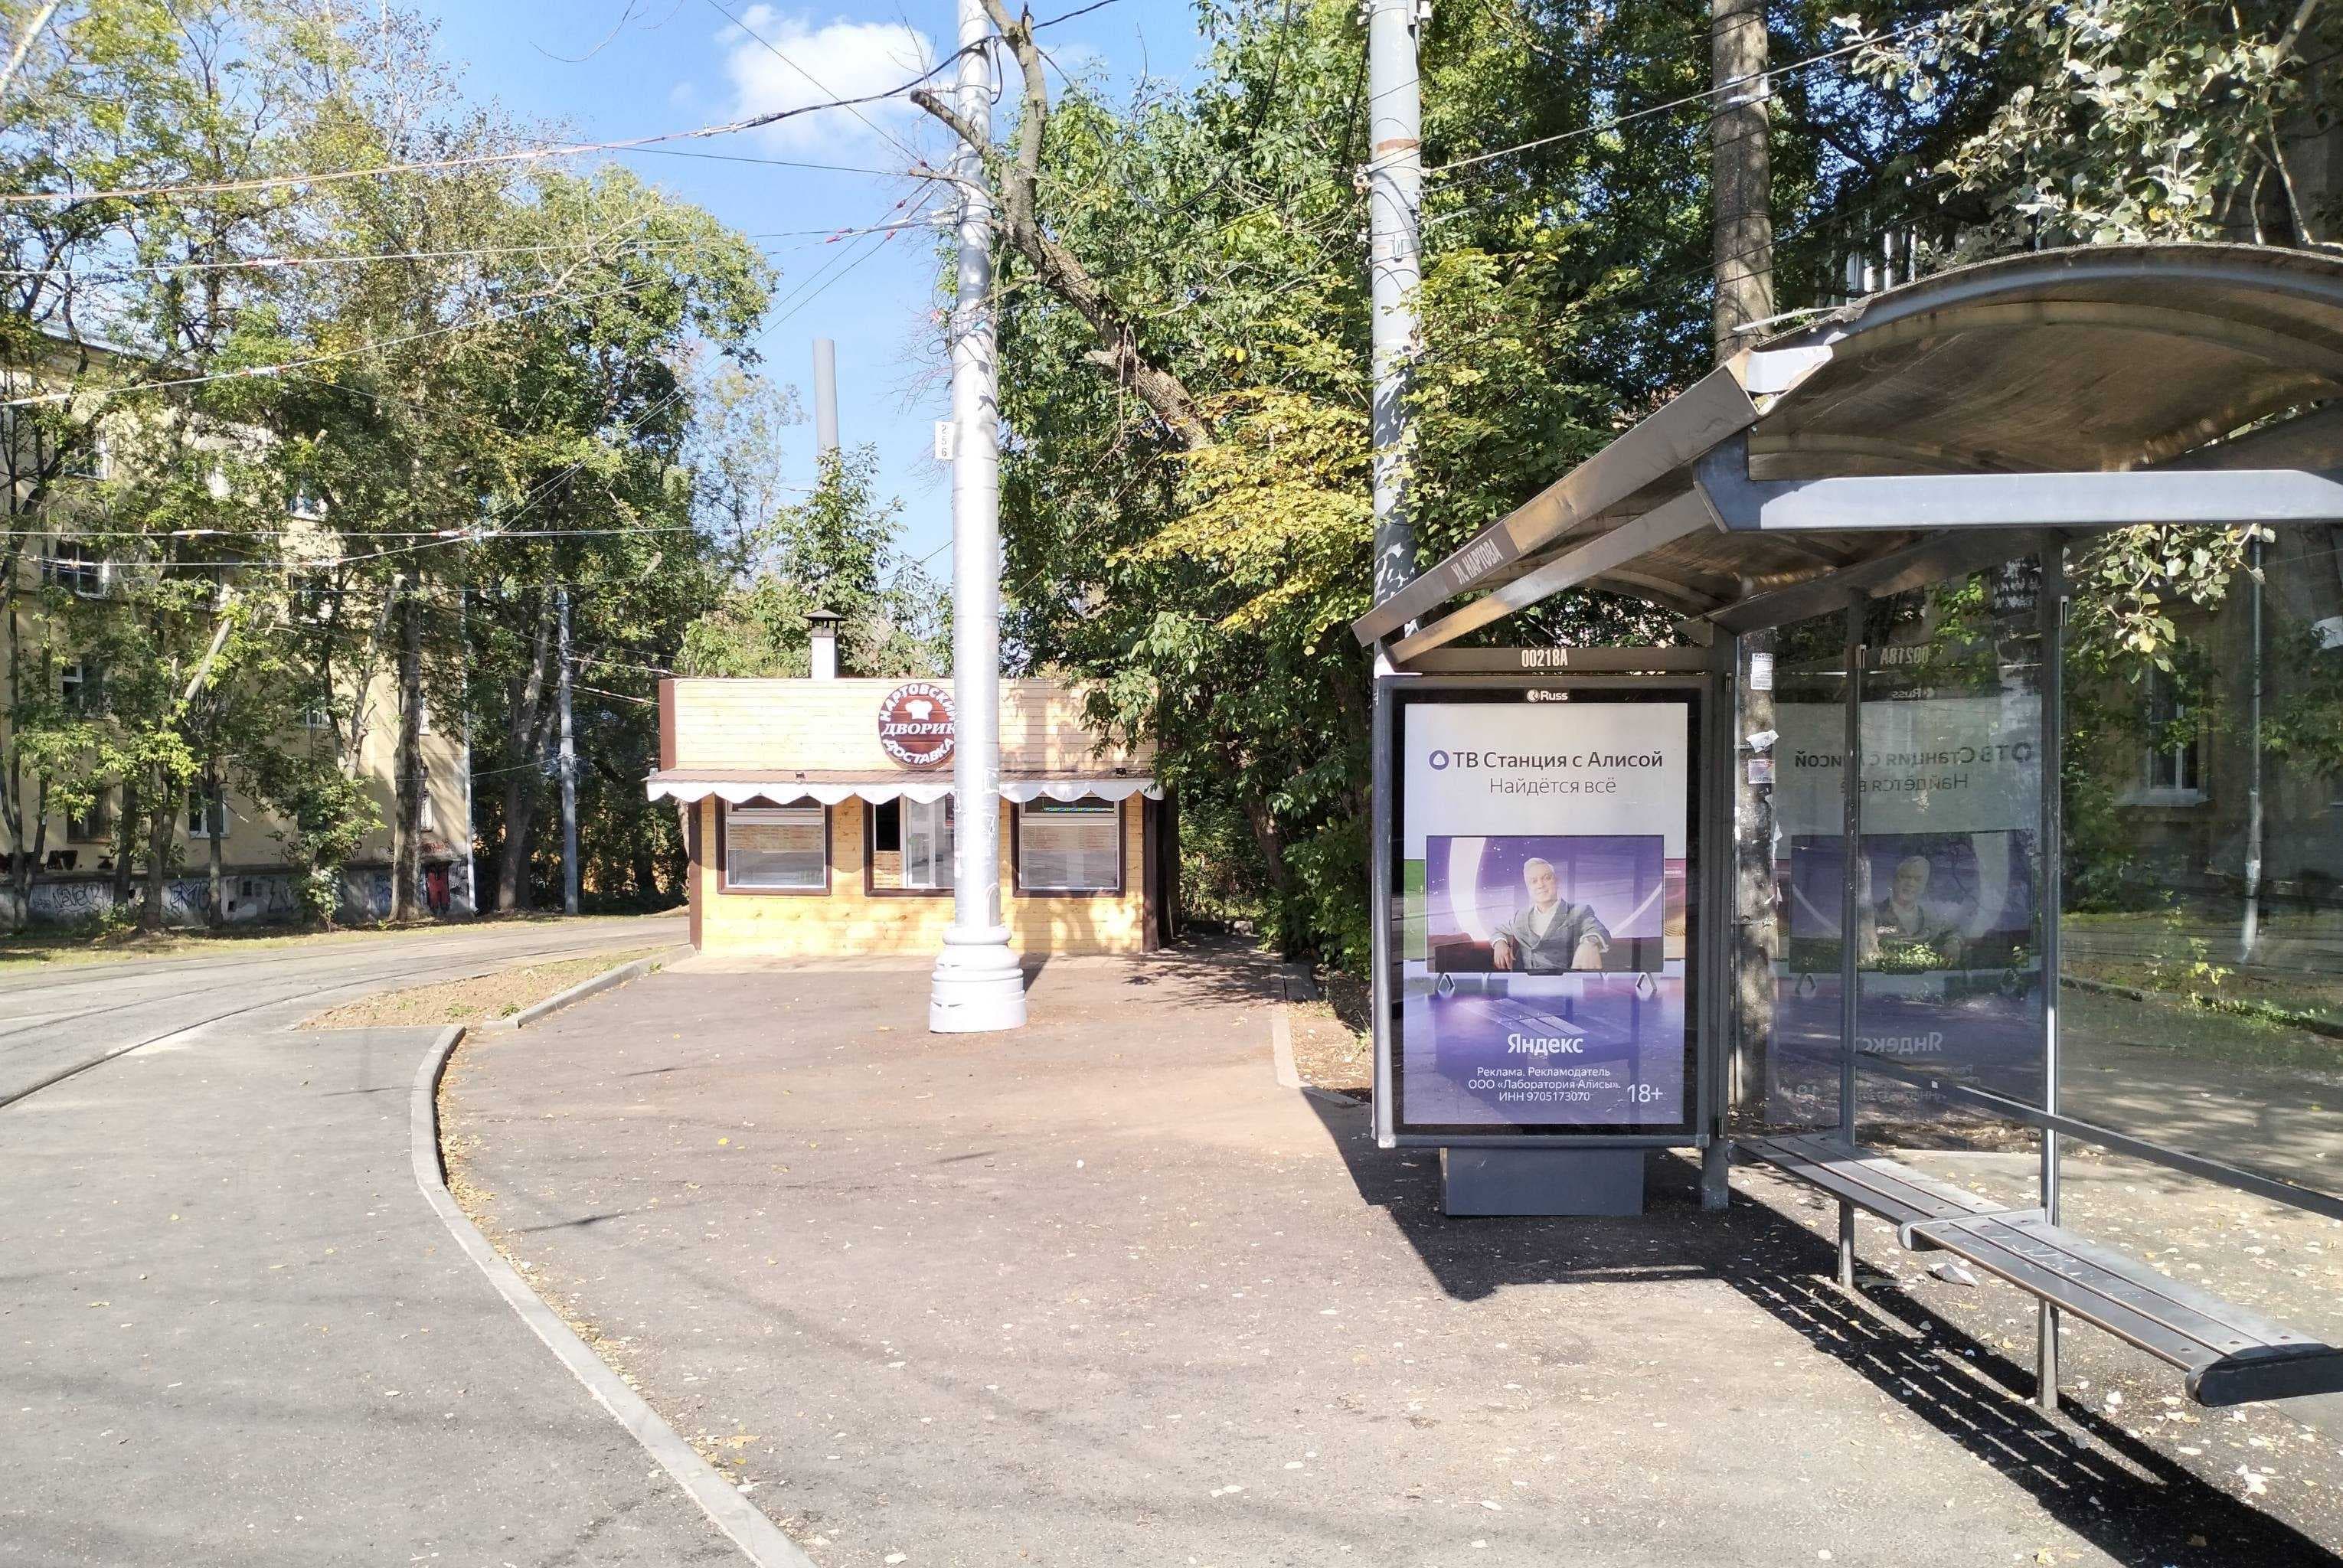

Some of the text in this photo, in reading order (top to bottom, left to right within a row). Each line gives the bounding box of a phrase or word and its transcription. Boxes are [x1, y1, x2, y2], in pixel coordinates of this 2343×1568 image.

[1461, 537, 1504, 579] НАРТОВА
[1521, 648, 1568, 668] 00218A
[1540, 690, 1568, 701] Russ
[882, 738, 955, 764] ДОСТАВКА
[1453, 750, 1663, 770] ТВ Станция с Алисой
[1489, 777, 1616, 796] Найдётся всё
[1507, 1034, 1583, 1056] Яндекс
[1477, 1067, 1611, 1079] Реклама. Рекламодатель
[1468, 1079, 1495, 1089] ООО
[1497, 1079, 1575, 1090] «Лаборатория
[1627, 1083, 1664, 1103] 18+
[1499, 1092, 1591, 1102] ИНН 9705173070
